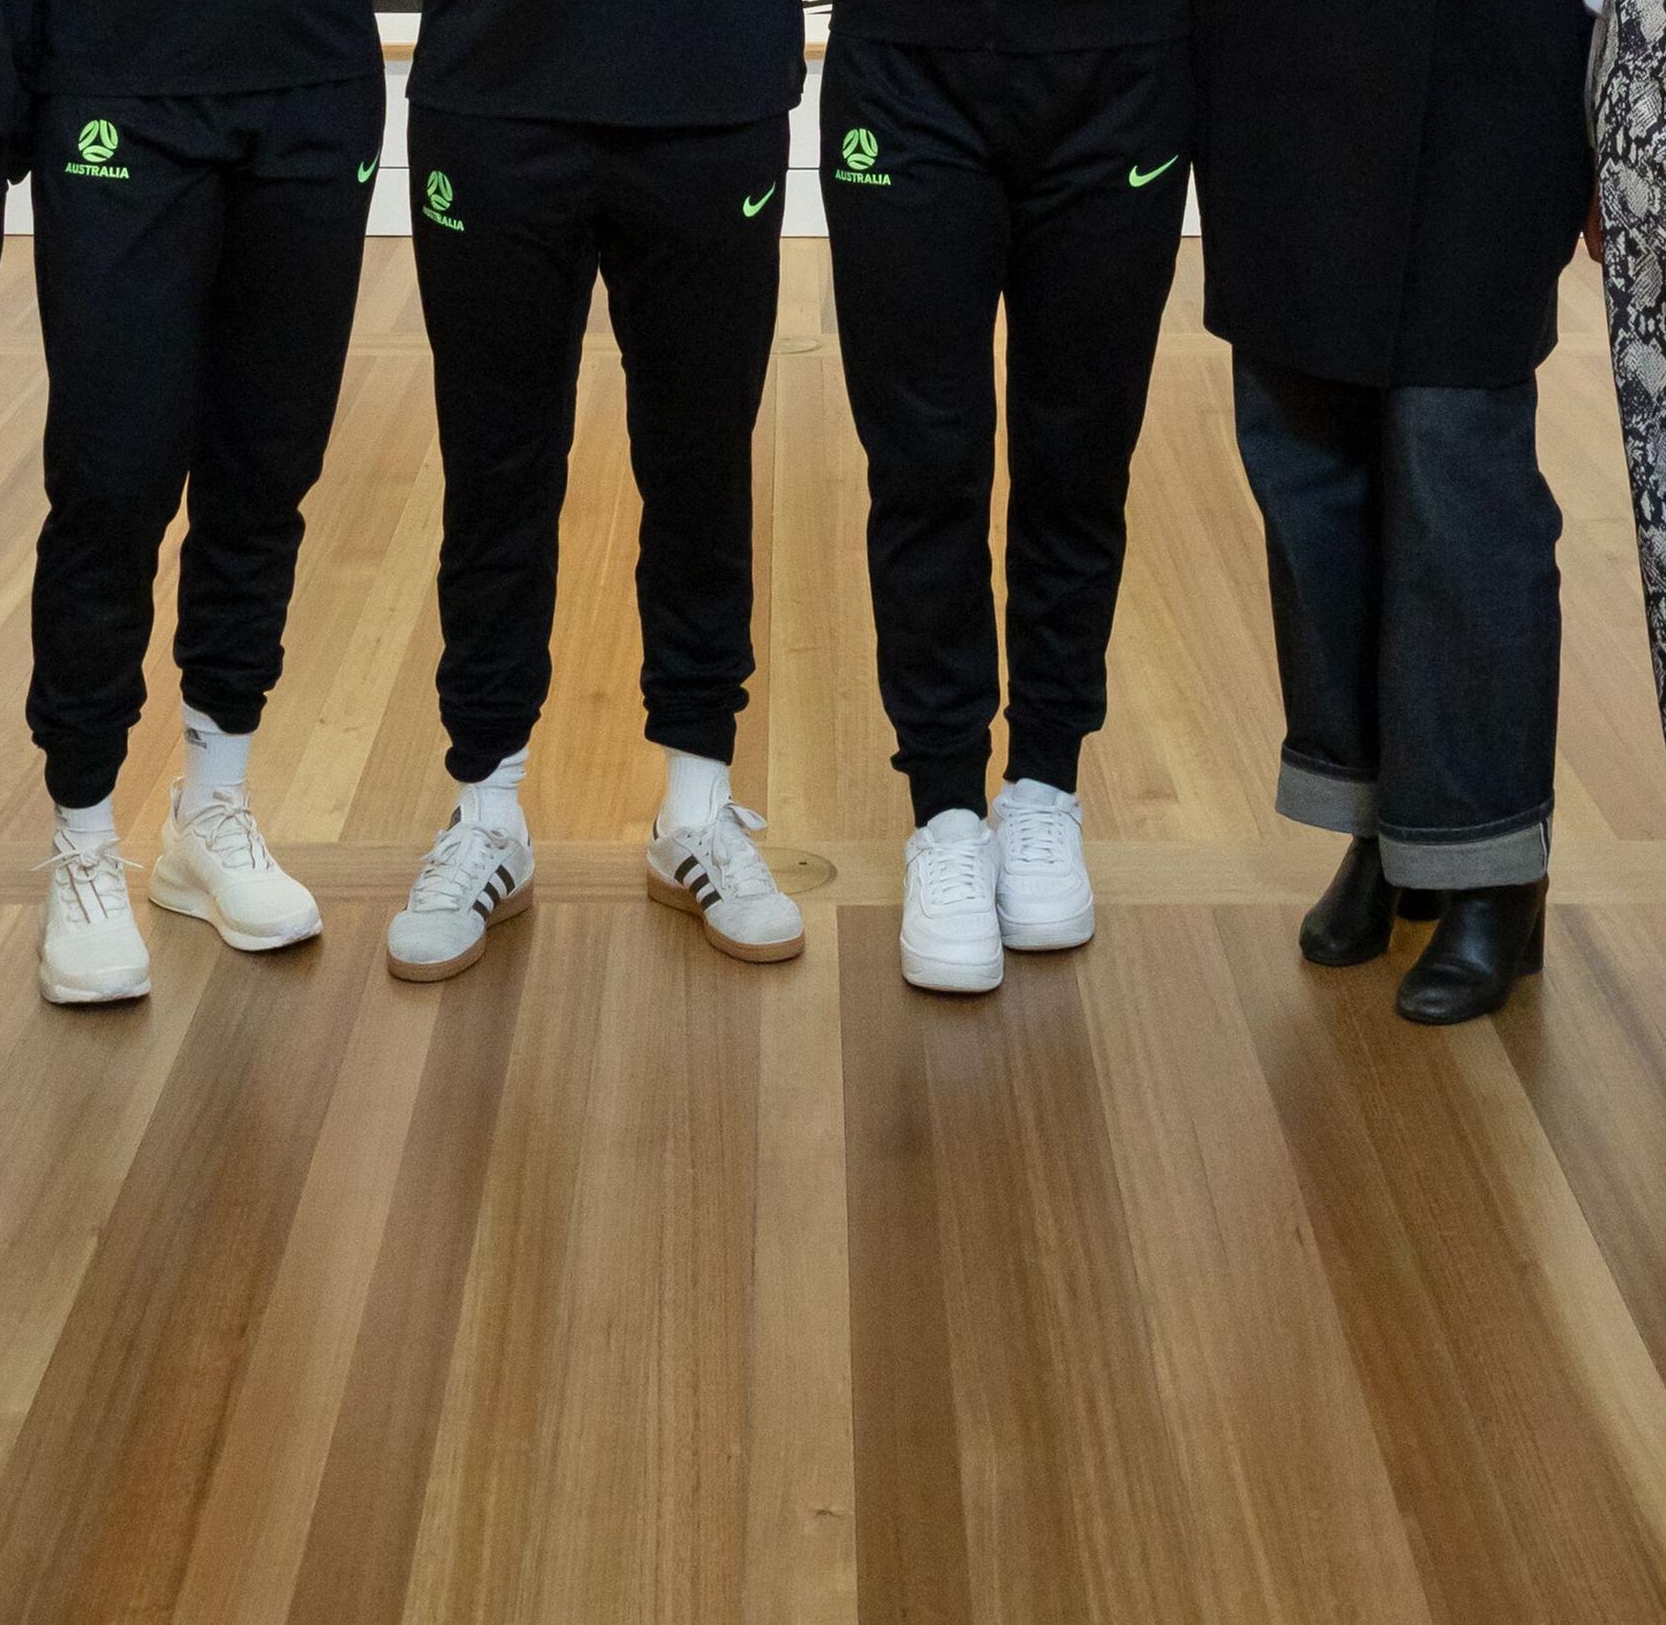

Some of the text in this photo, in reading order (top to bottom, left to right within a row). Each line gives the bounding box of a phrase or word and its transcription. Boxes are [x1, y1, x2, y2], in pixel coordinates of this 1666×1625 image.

[65, 162, 130, 179] AUSTRALIA
[835, 169, 891, 186] AUSTRALIA
[422, 205, 464, 231] RALIA
